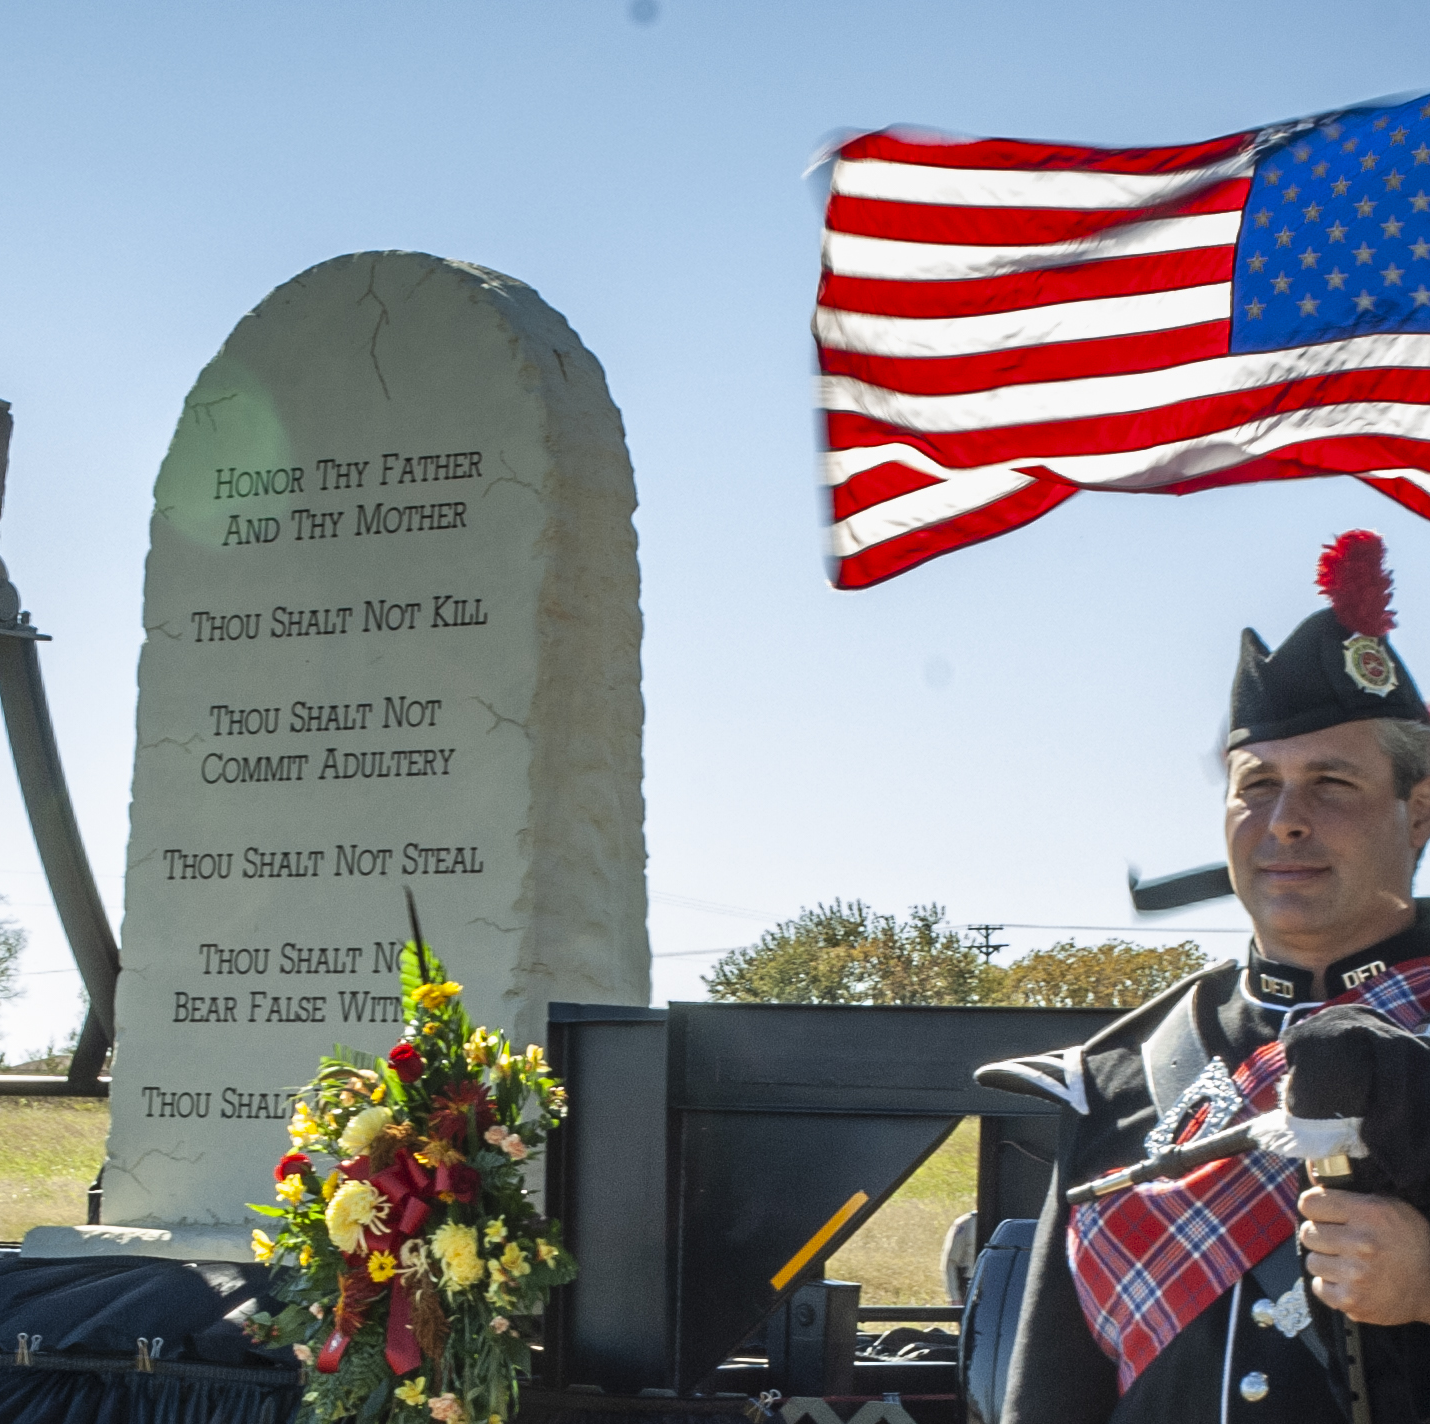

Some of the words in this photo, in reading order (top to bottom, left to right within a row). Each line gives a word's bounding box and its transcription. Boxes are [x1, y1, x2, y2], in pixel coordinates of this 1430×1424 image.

[214, 467, 304, 499] HONOR
[317, 459, 369, 491] THY
[380, 451, 482, 485] FATHER
[222, 515, 280, 546] AND
[292, 509, 344, 541] THY
[355, 502, 466, 536] MOTHER
[192, 611, 261, 642] THOU
[271, 606, 352, 638] SHALT
[362, 600, 421, 632] NOT
[431, 595, 487, 628] KILL
[210, 705, 280, 736] THOU
[290, 701, 372, 733] SHALT
[382, 696, 442, 728] NOT
[202, 753, 308, 784] COMMIT
[318, 748, 455, 780] ADULTERY
[164, 849, 233, 880] THOU
[243, 847, 324, 879] SHALT
[334, 845, 393, 876] NOT
[402, 843, 483, 875] STEAL
[200, 944, 270, 975] THOU
[280, 943, 362, 974] SHALT
[173, 992, 237, 1022] BEAR
[248, 991, 326, 1022] FALSE
[142, 1087, 211, 1118] THOU
